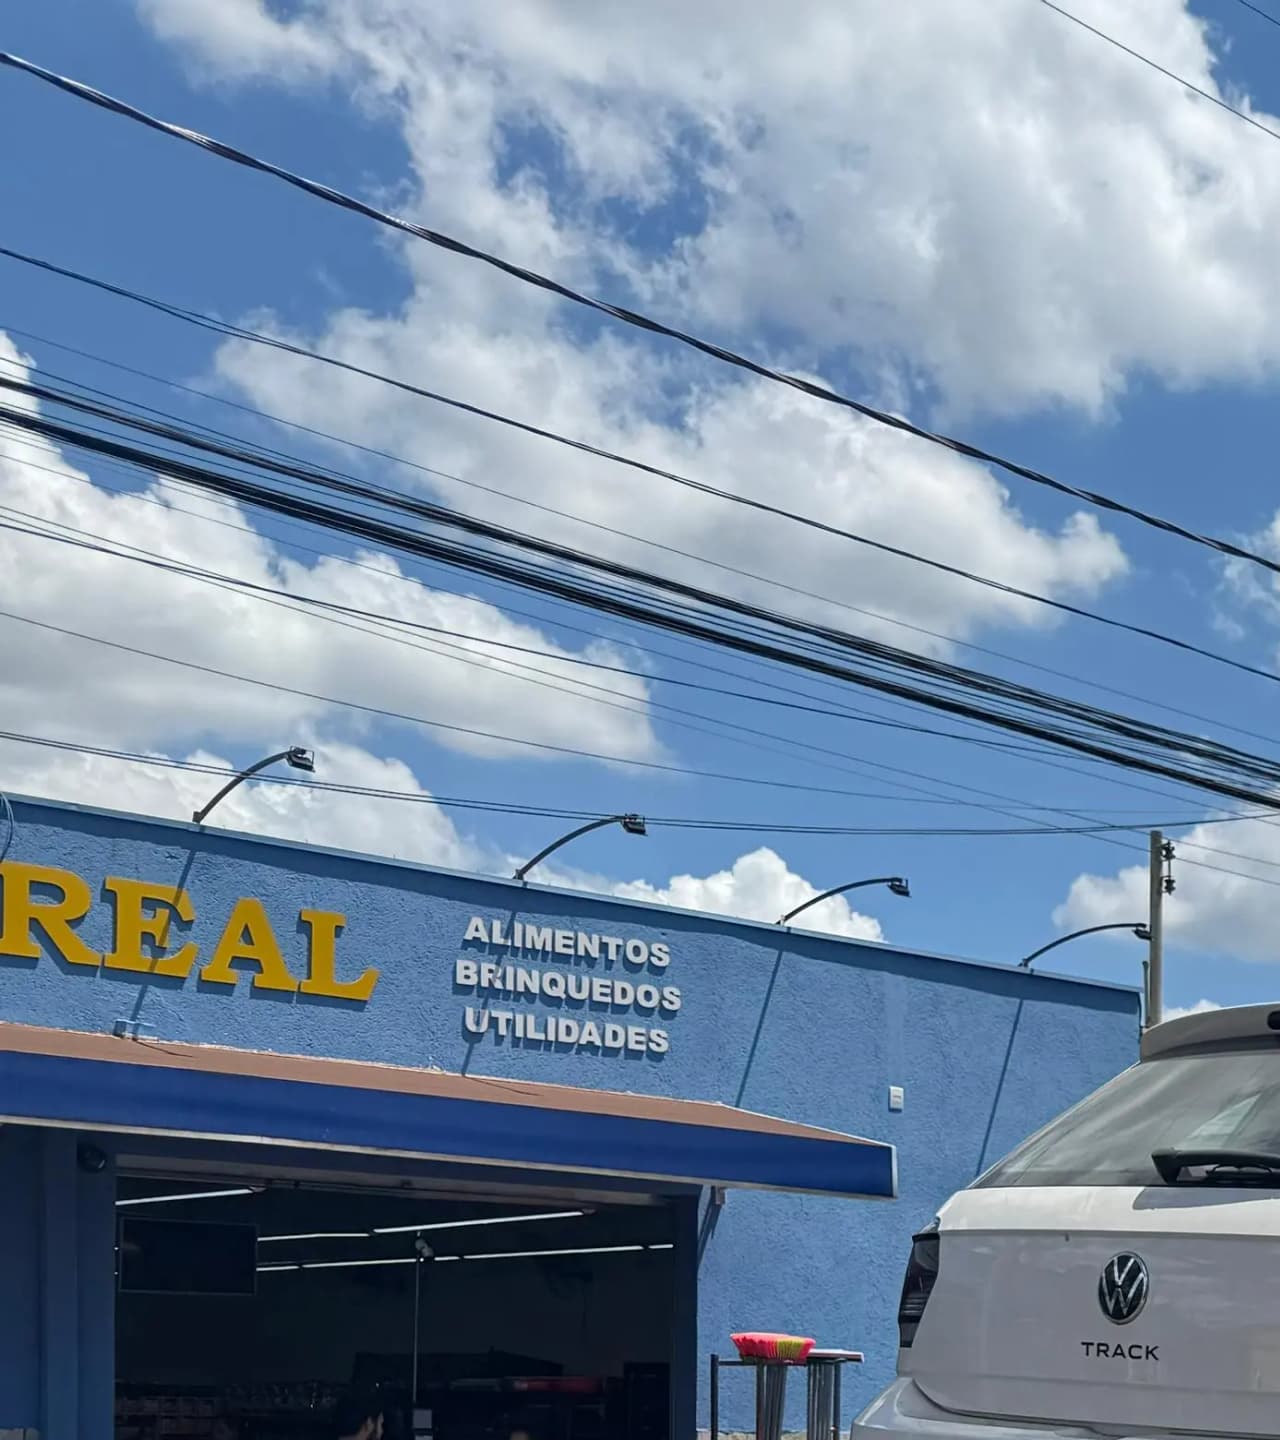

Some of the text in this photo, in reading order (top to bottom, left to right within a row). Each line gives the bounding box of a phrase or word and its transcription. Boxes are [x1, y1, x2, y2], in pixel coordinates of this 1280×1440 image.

[0, 861, 380, 1001] REAL
[463, 916, 671, 967] ALIMENTOS
[455, 959, 682, 1012] BRINQUEDOS
[465, 1006, 670, 1053] UTILIDADES
[1080, 1341, 1160, 1361] TRACK
